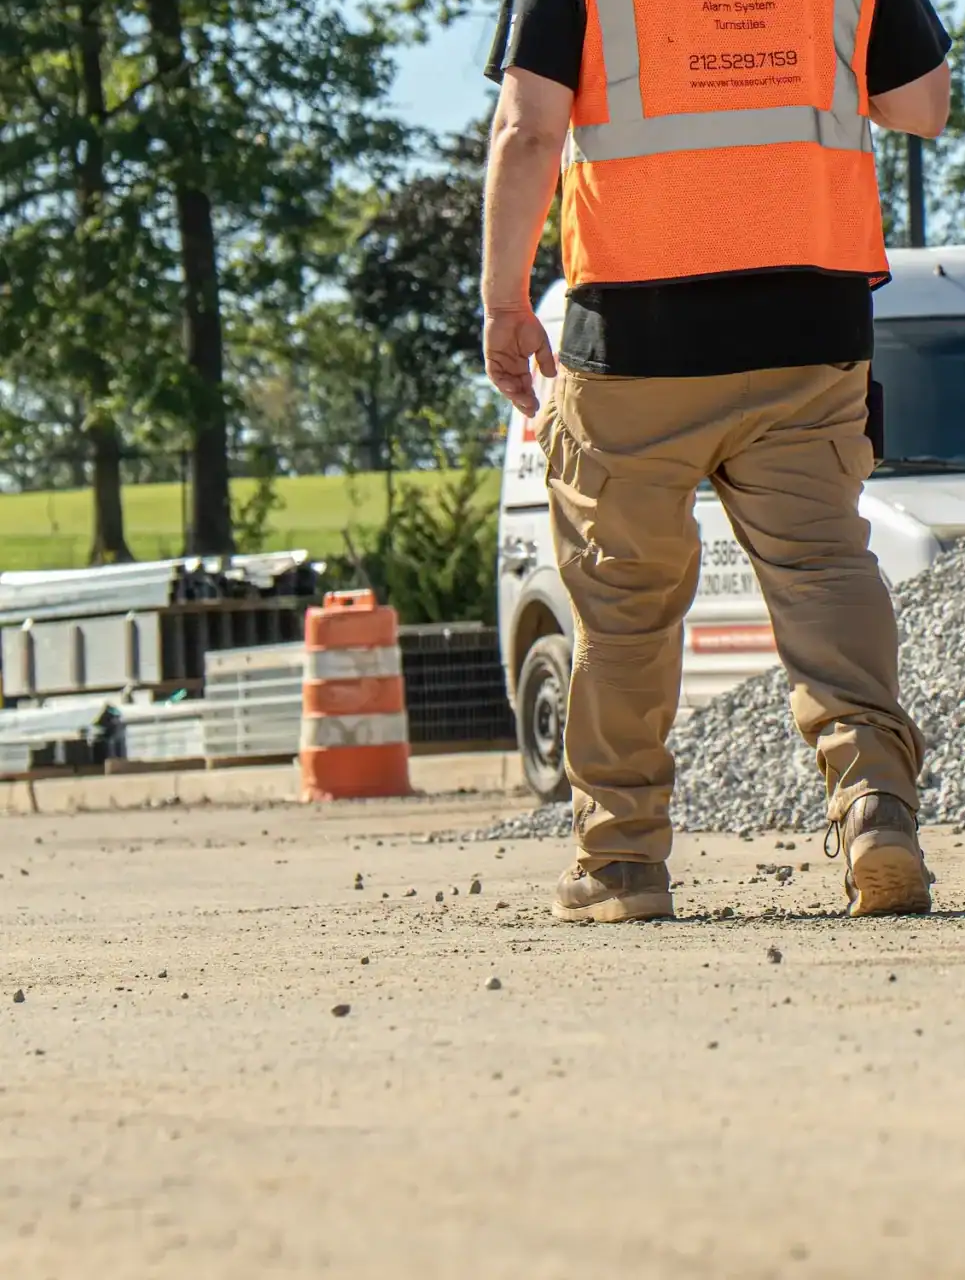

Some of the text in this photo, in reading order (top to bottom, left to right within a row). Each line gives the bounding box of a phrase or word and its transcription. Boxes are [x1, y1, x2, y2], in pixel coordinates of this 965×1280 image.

[702, 0, 776, 13] Alarm System
[714, 19, 766, 29] Turnstiles
[689, 50, 798, 70] 212.529.7159
